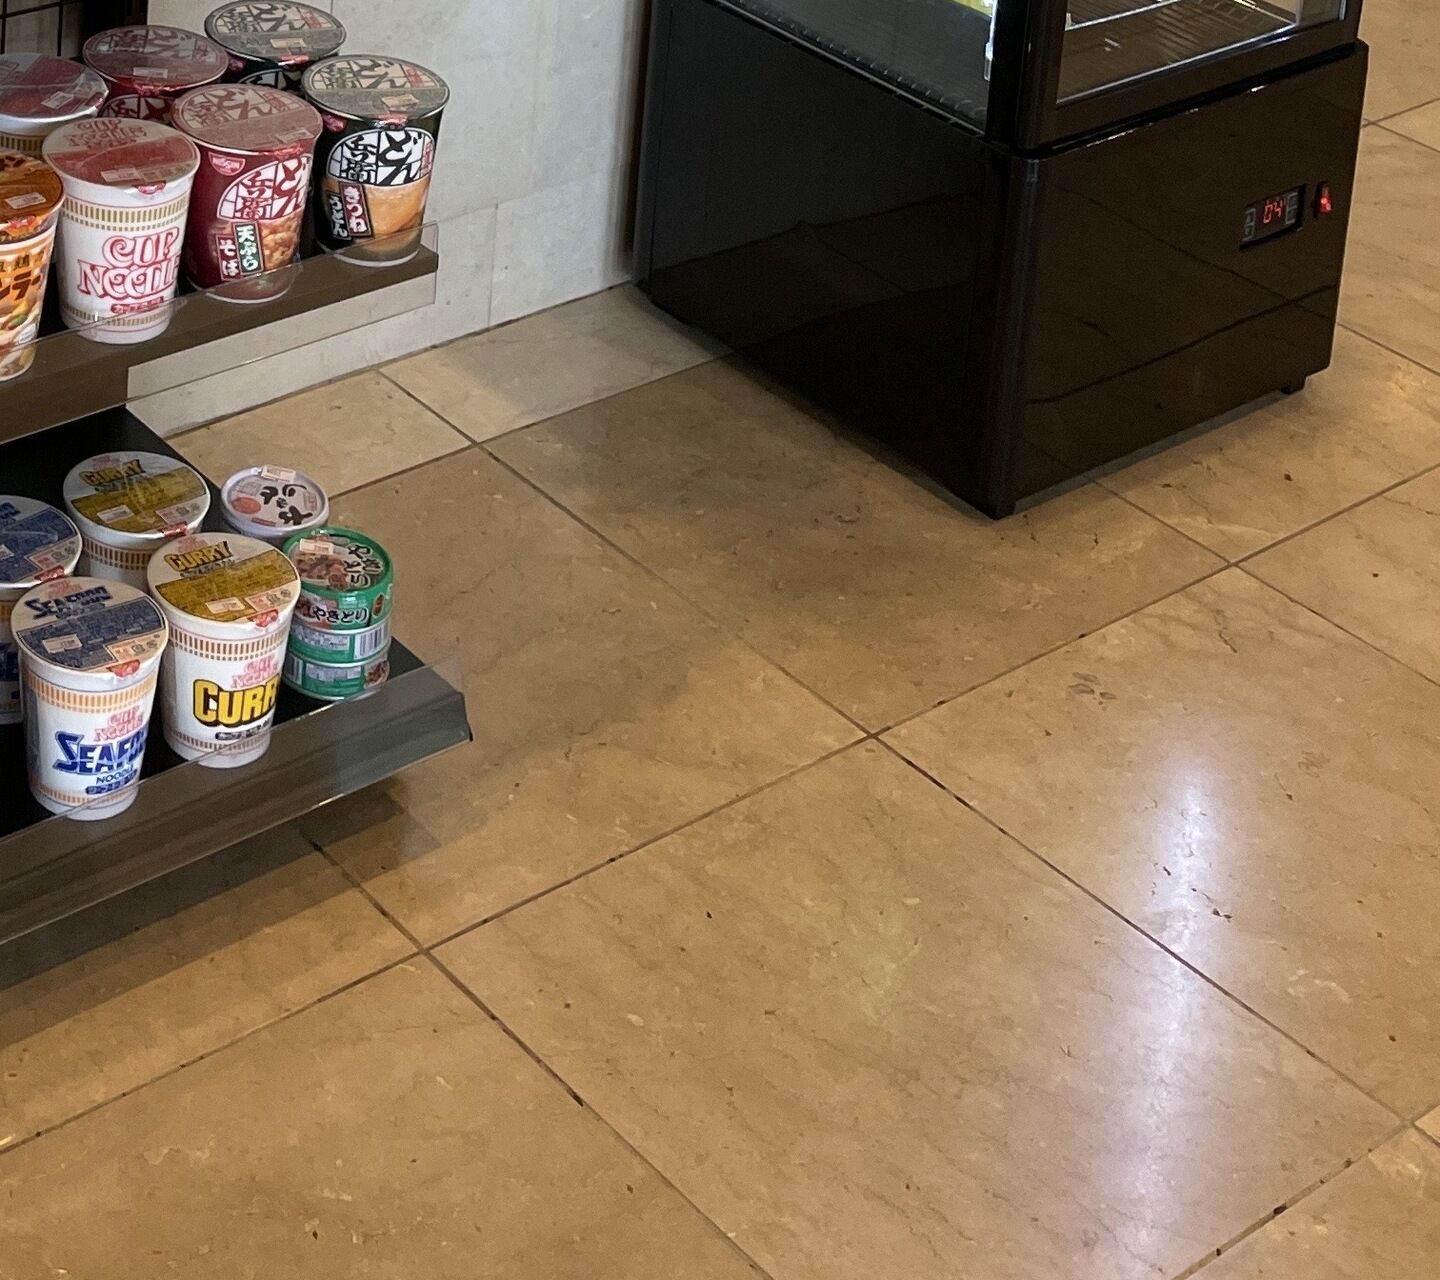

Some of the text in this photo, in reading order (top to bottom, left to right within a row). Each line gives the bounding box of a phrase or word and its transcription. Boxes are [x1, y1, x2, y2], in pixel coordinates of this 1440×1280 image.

[328, 194, 349, 239] うどん
[342, 184, 368, 235] きつね
[103, 228, 172, 268] CUP
[219, 239, 240, 280] そば
[235, 225, 260, 272] 天ぷら
[312, 606, 369, 625] やきとり
